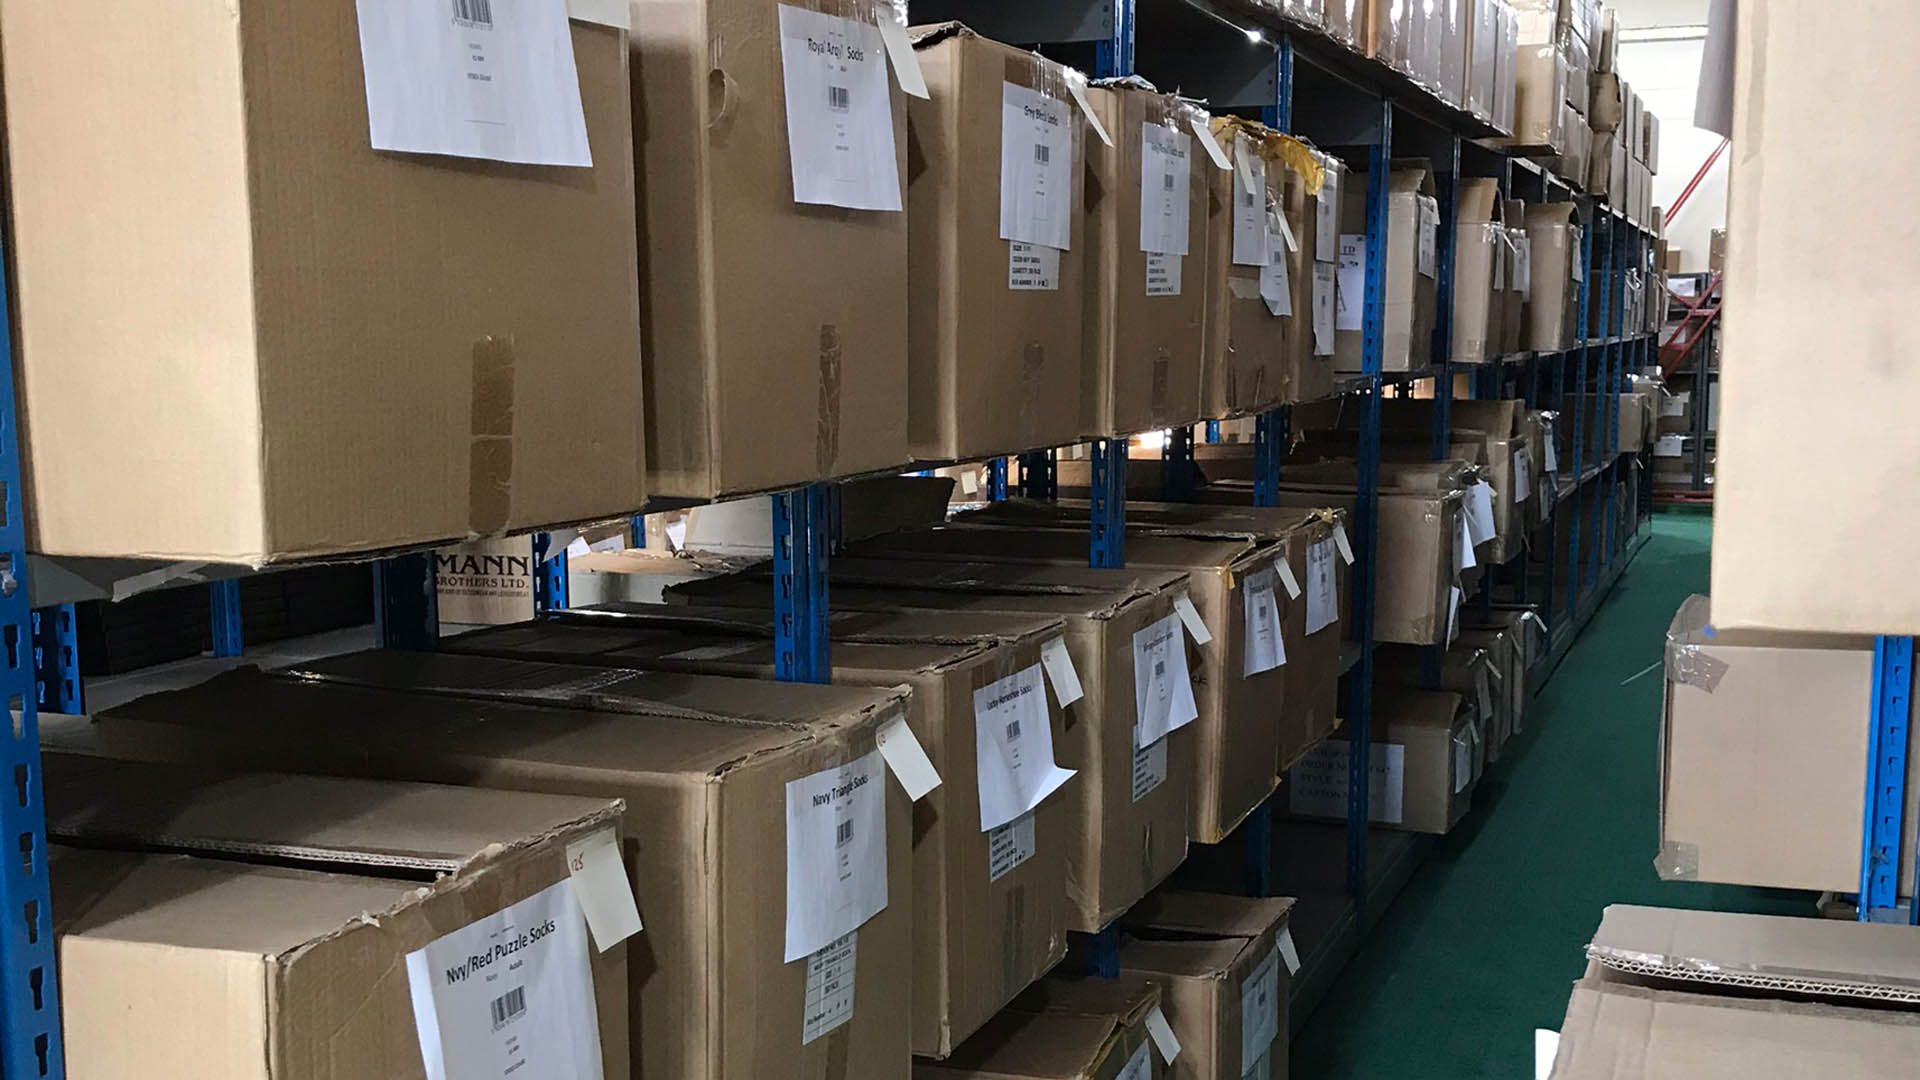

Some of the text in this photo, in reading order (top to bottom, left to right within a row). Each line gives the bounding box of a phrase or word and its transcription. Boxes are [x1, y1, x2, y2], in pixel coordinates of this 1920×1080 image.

[807, 37, 826, 56] Royal
[436, 554, 530, 576] MANN
[437, 576, 530, 589] ROTHERS LTD.
[812, 789, 831, 808] Navy
[446, 948, 493, 986] Nvy/Red
[494, 934, 529, 962] Puzzle
[529, 918, 556, 945] Socks
